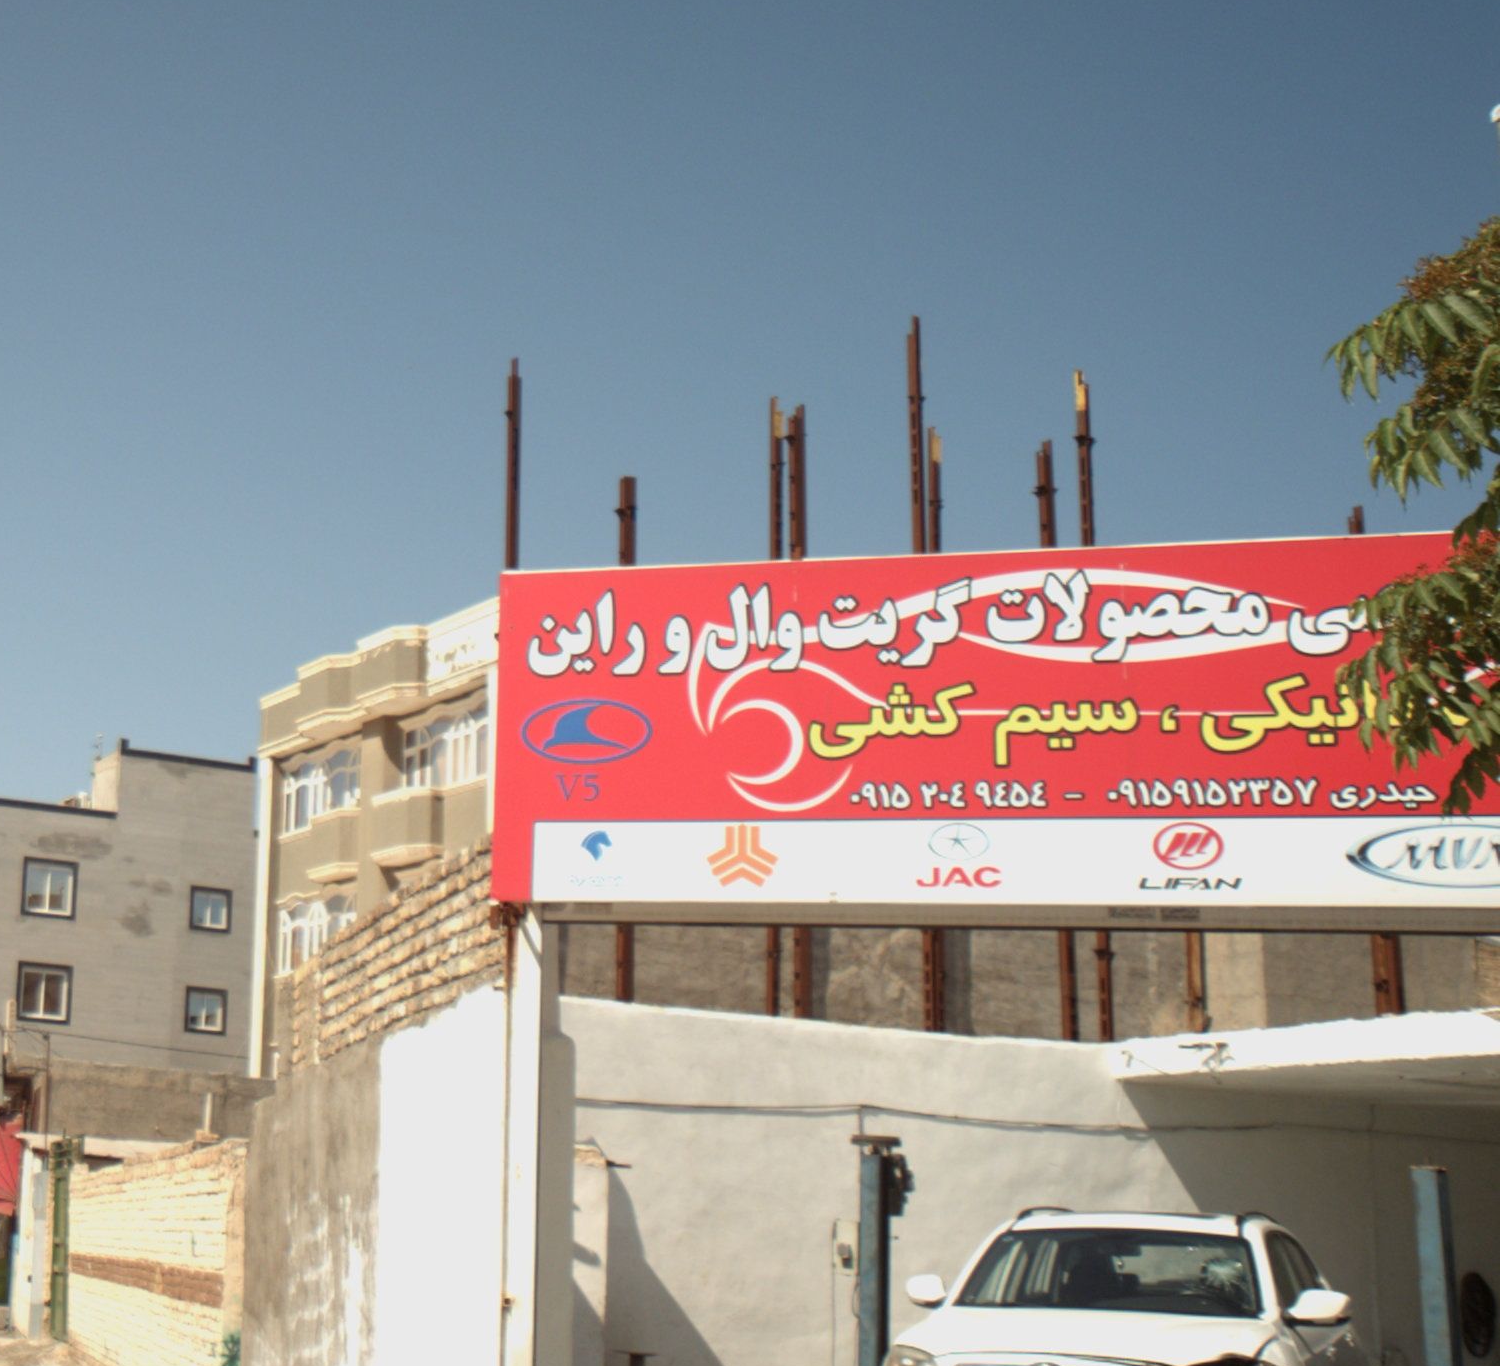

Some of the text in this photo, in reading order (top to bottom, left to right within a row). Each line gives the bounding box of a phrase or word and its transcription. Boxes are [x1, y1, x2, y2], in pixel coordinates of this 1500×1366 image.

[527, 588, 647, 677] راین
[657, 612, 692, 675] و
[703, 582, 804, 672] وال
[817, 576, 973, 668] گریت
[985, 569, 1270, 663] محصولات
[808, 681, 978, 760] کشی
[993, 698, 1140, 768] سیم
[1200, 673, 1472, 755] انیکی
[556, 773, 601, 802] V5
[1329, 781, 1438, 810] حیدری
[916, 866, 1002, 888] JAC
[1138, 877, 1243, 891] LIFAN
